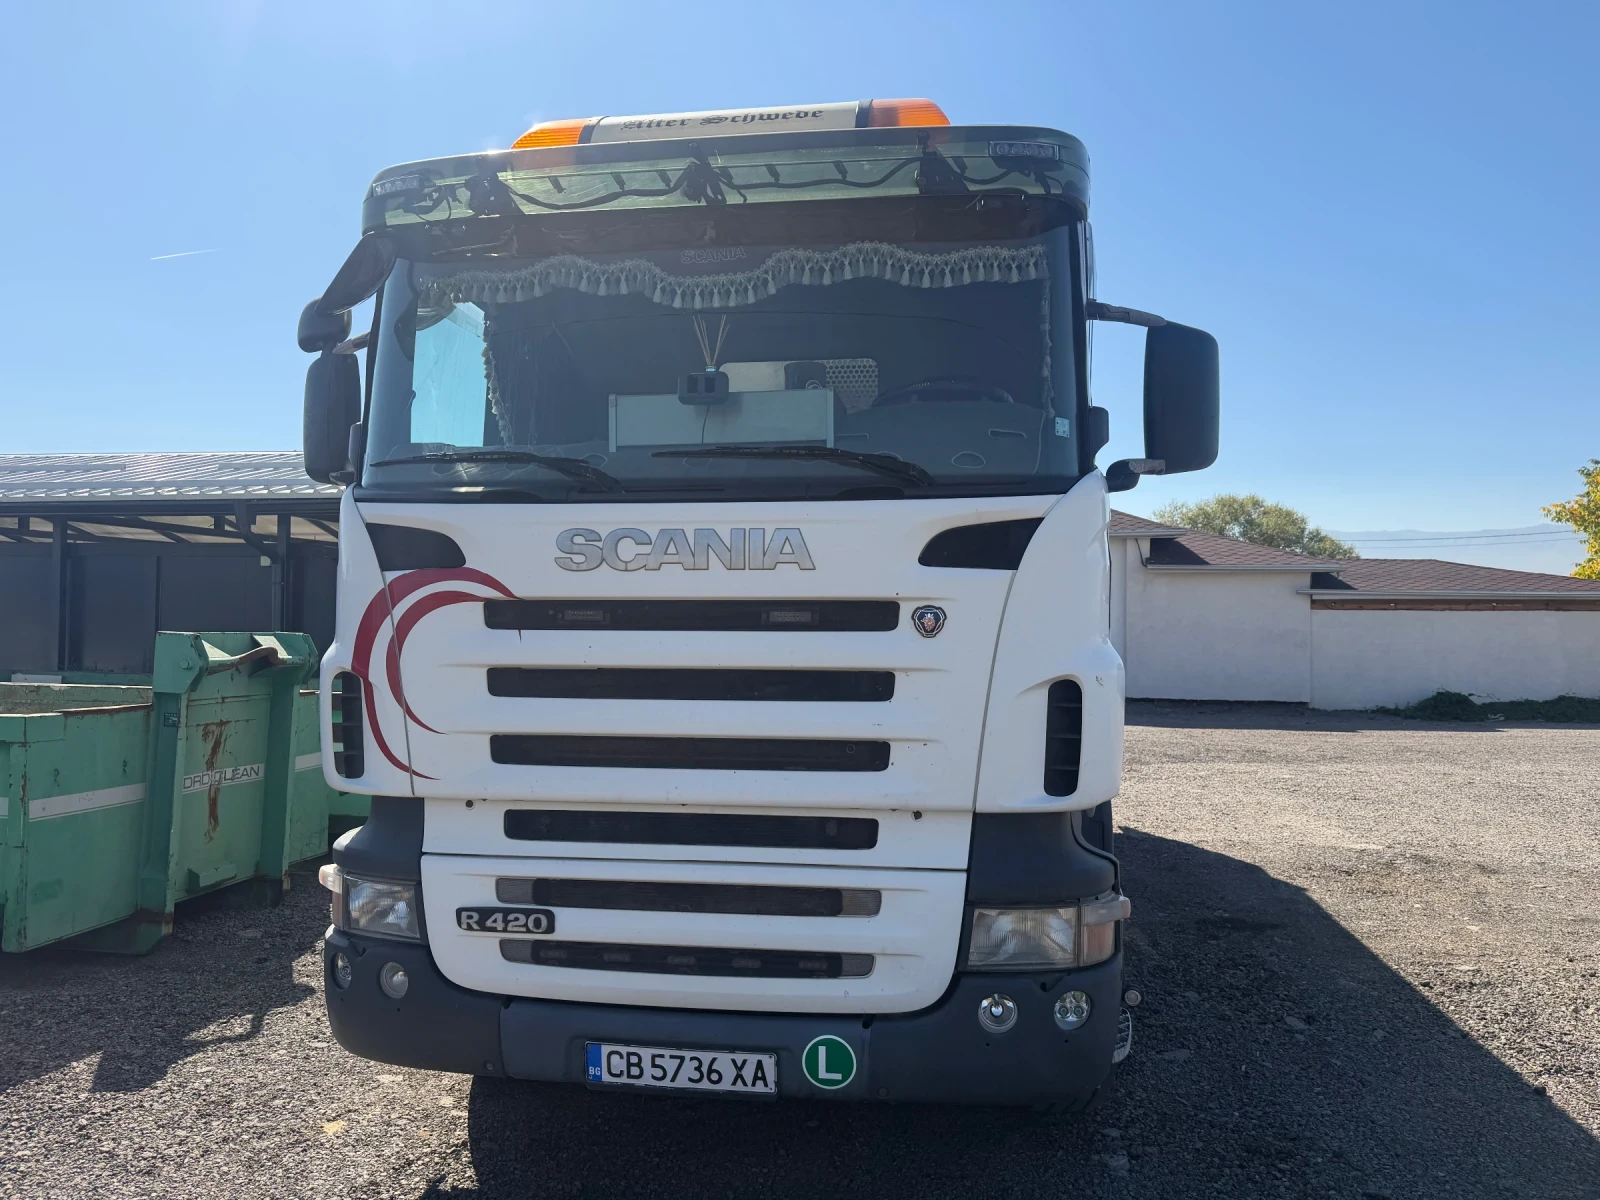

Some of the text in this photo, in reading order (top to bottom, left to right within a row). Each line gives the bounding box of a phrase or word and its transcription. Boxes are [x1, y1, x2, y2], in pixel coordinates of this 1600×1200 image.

[620, 110, 825, 131] Alter Schwede
[680, 245, 747, 264] SCANIA
[554, 527, 817, 572] SCANIA
[460, 911, 548, 933] R 420
[588, 1066, 601, 1076] BG
[606, 1050, 769, 1088] CB 5736 XA
[818, 1045, 843, 1080] L
